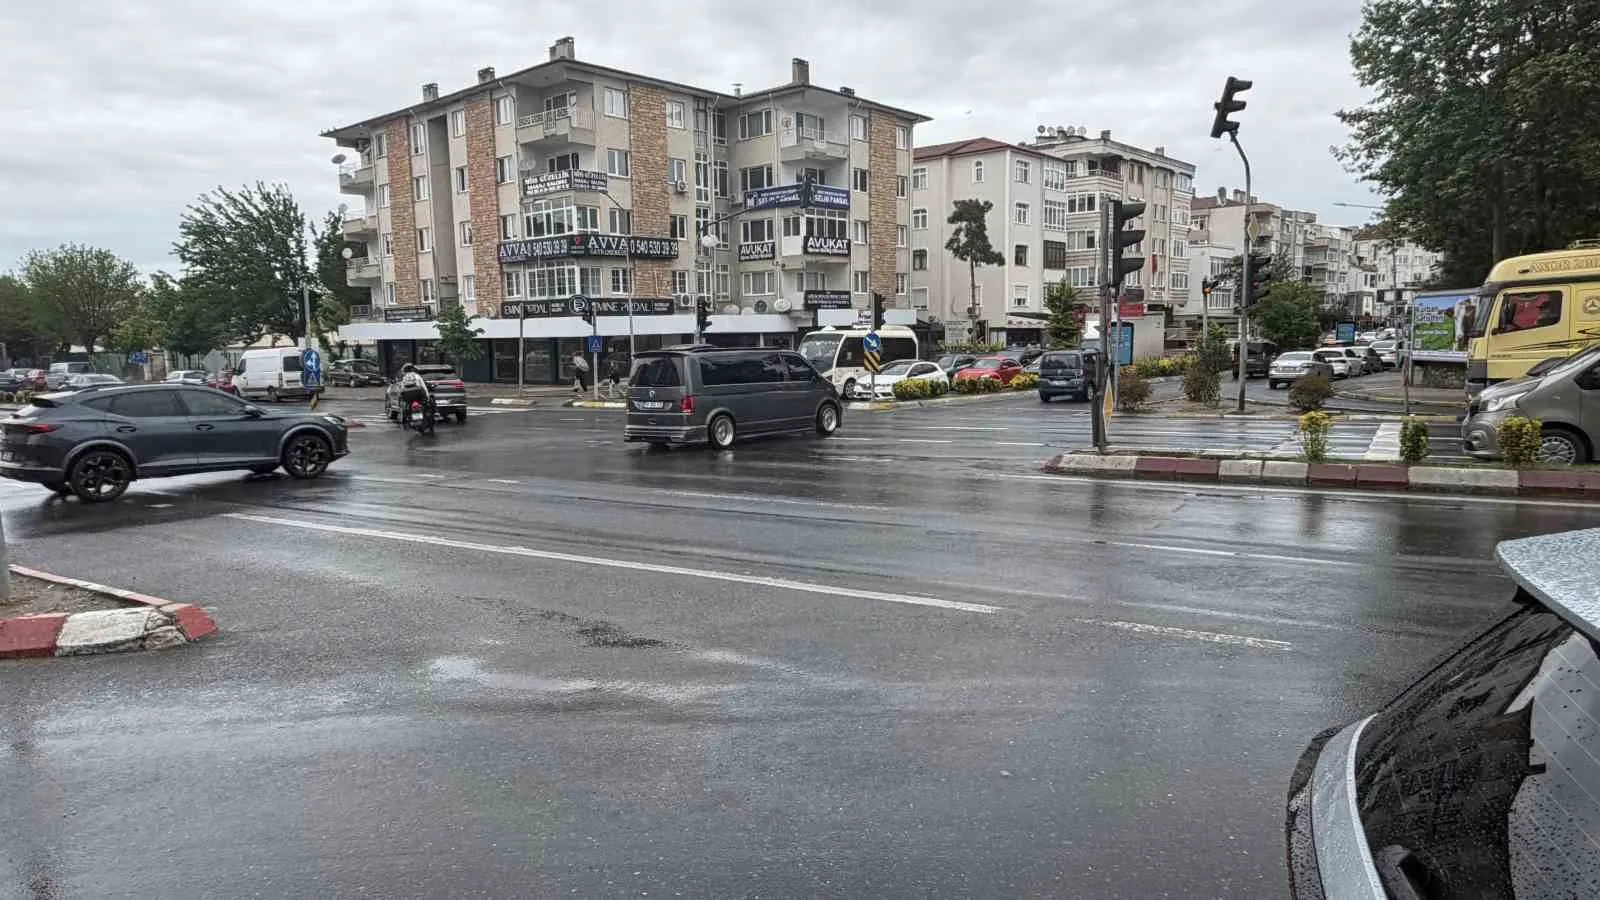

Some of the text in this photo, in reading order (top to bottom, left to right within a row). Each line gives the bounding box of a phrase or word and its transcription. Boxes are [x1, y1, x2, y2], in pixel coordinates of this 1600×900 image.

[499, 242, 527, 257] AVVA
[588, 235, 628, 249] AVVA
[630, 239, 635, 254] 0
[636, 240, 648, 254] 540
[648, 241, 661, 255] 530
[741, 243, 772, 256] AVUKAT
[807, 236, 848, 249] AVUKAT
